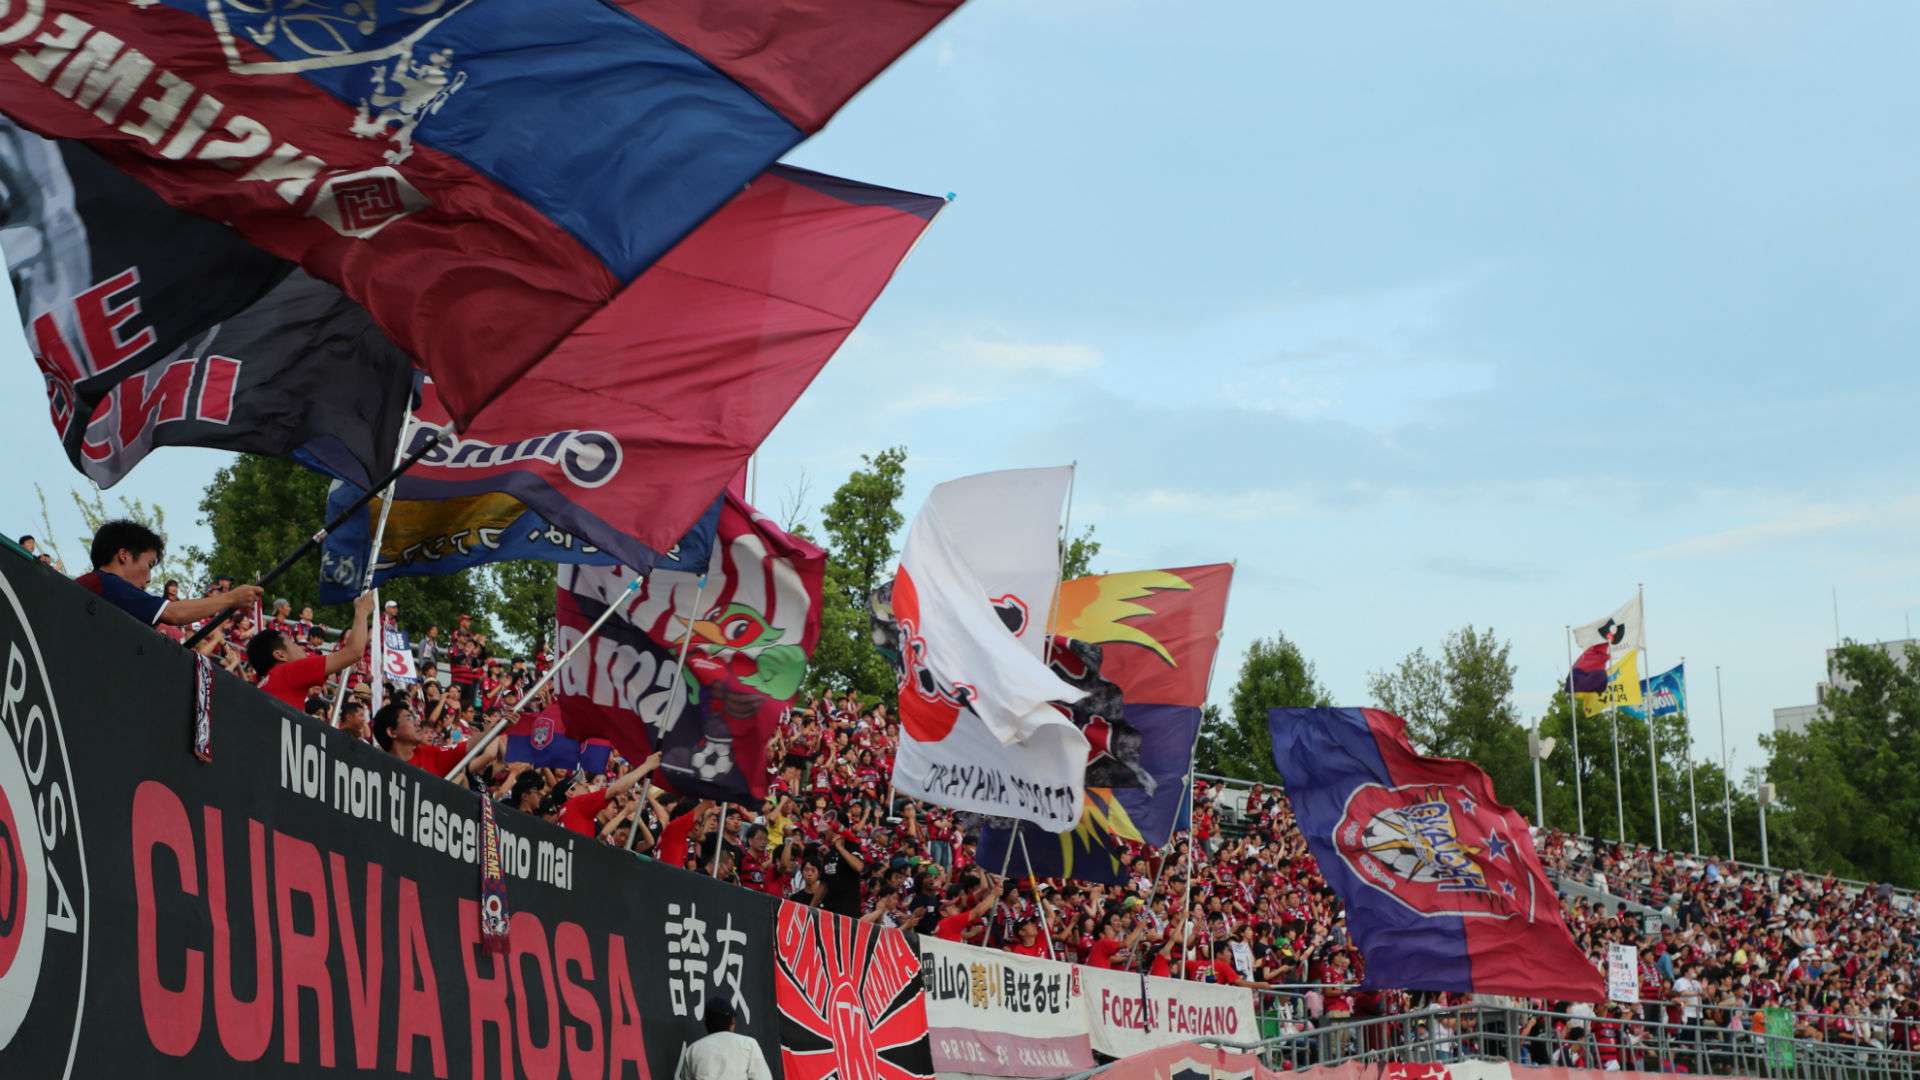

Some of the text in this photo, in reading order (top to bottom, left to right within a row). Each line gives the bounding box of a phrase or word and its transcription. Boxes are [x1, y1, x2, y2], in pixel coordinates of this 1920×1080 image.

[386, 649, 409, 676] 3
[1, 640, 77, 934] ROSA
[280, 717, 326, 803] Noi
[334, 758, 382, 822] non
[389, 770, 406, 837] ti
[537, 838, 574, 891] mai
[131, 780, 652, 1080] CURVA ROSA
[940, 1039, 987, 1063] PRIDE
[1168, 997, 1239, 1036] FAGIANO
